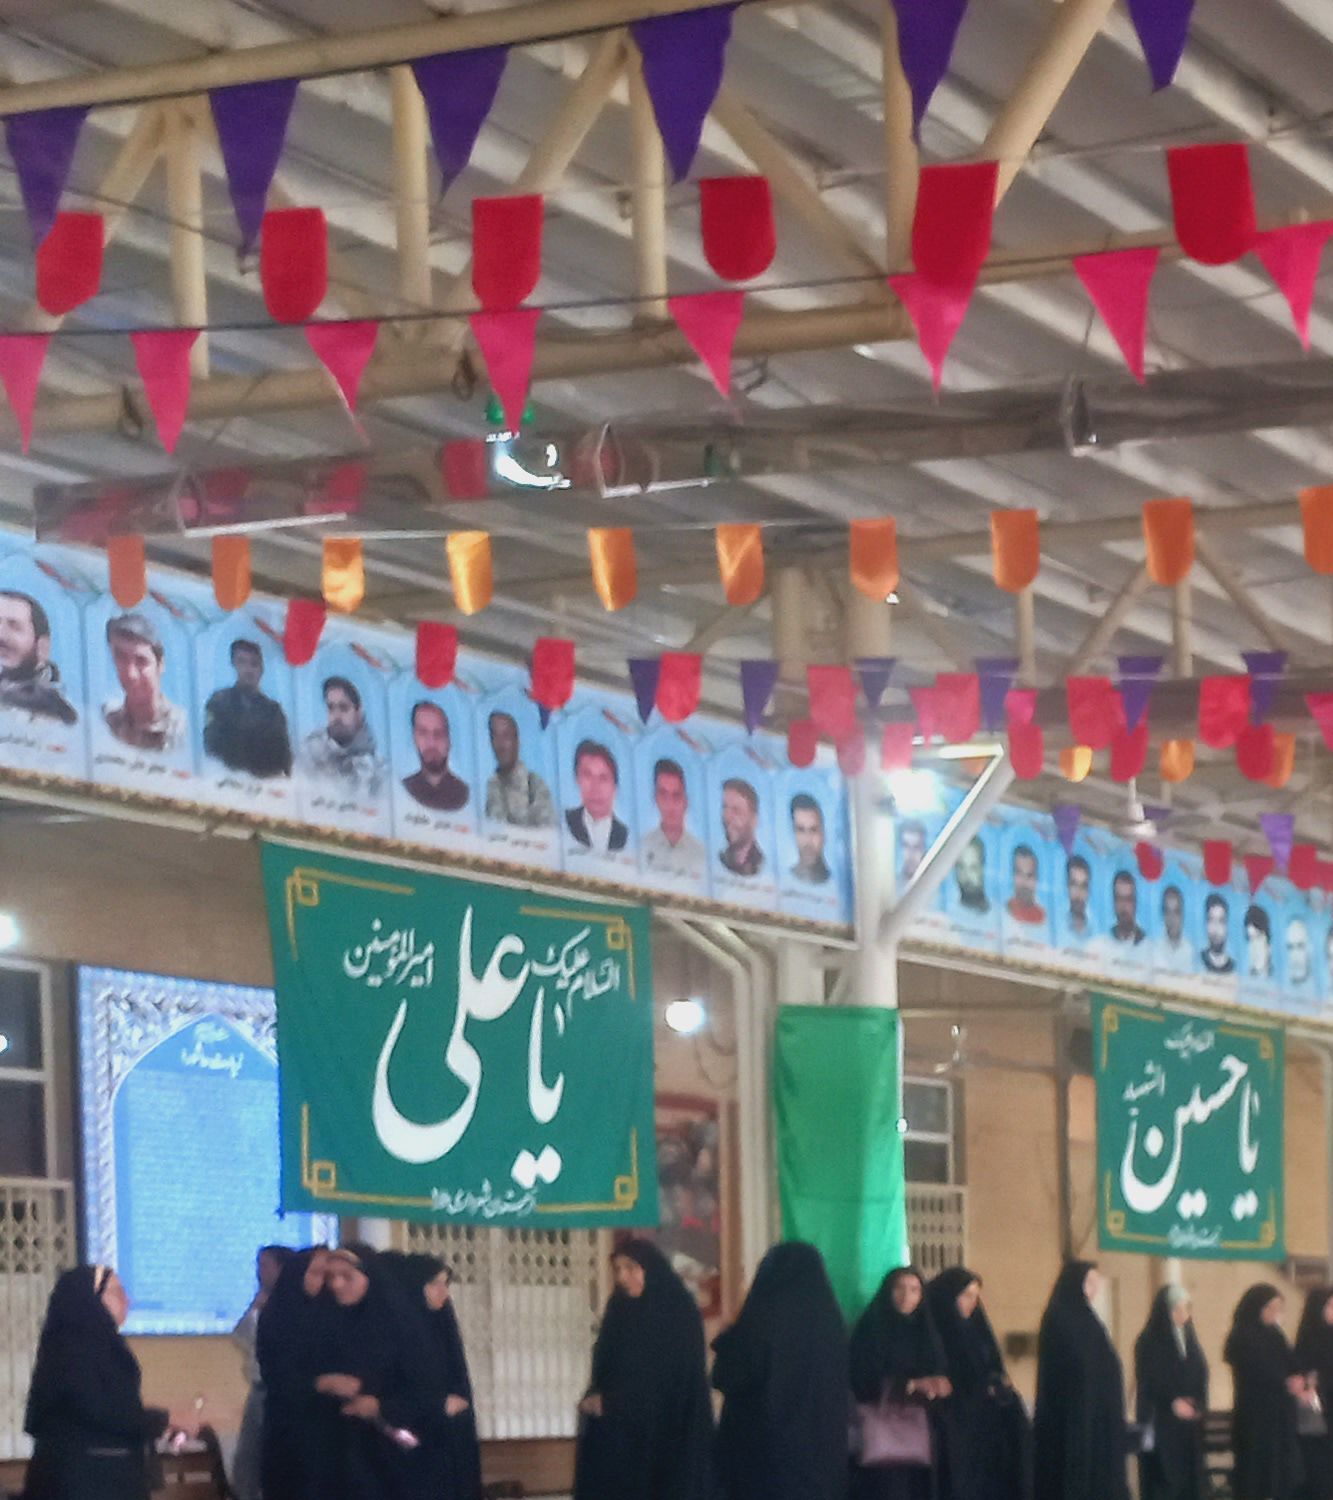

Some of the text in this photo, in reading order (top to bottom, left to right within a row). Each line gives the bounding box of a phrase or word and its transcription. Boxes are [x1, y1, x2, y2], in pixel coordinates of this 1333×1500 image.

[371, 903, 566, 1189] یا علی
[1119, 1053, 1261, 1223] یا حسین
